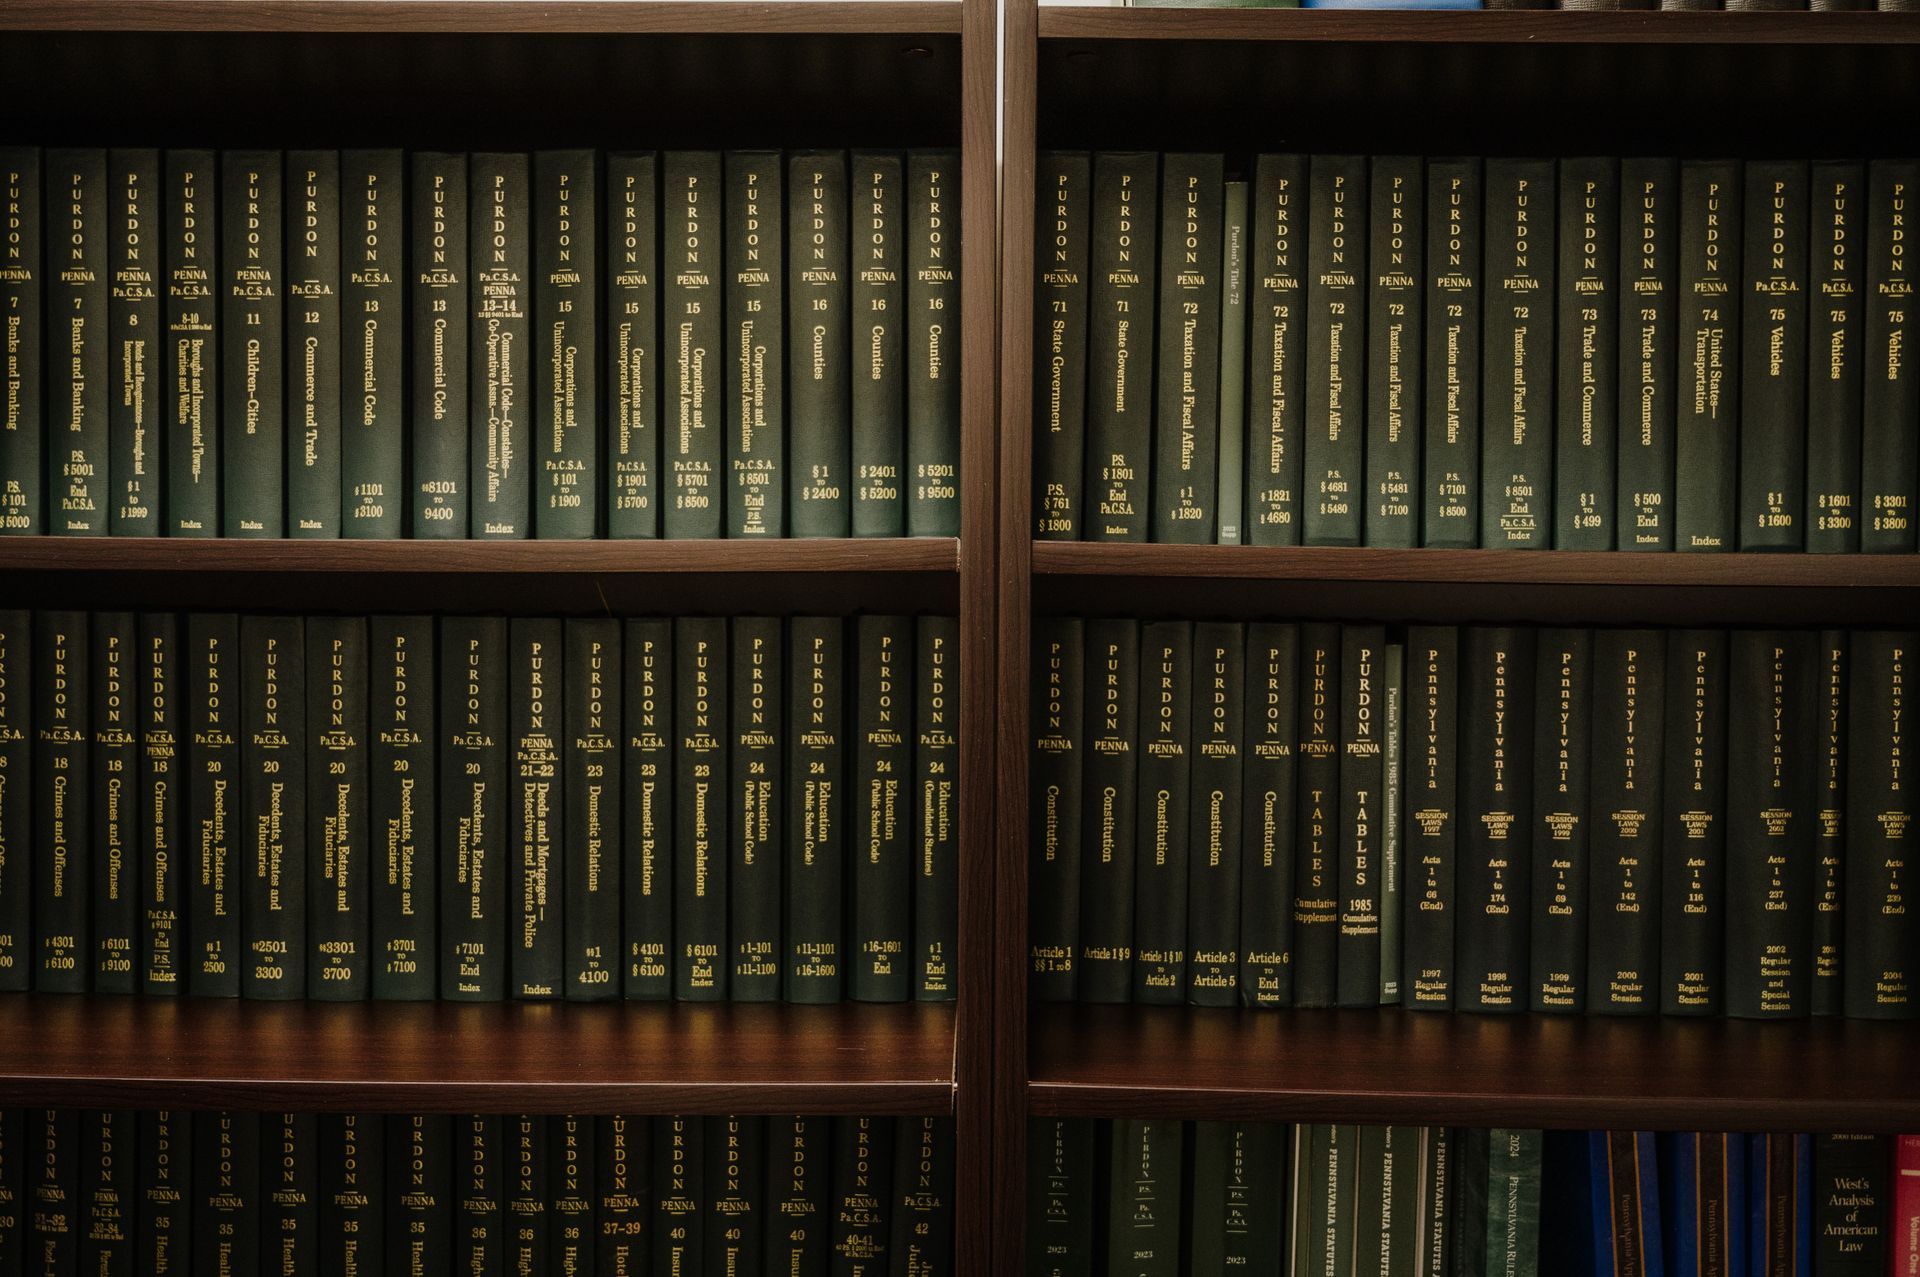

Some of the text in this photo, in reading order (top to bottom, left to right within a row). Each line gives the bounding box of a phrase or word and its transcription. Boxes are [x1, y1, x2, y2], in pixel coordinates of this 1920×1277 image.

[61, 271, 96, 281] PENNA
[421, 273, 459, 284] Pa.C.S.A.
[1044, 273, 1078, 283] PENNA
[1229, 270, 1241, 292] Title
[483, 285, 516, 296] PENNA
[1575, 281, 1604, 291] PENNA
[1755, 281, 1799, 291] Pa.C.S.A.
[74, 298, 82, 309] 7
[813, 299, 828, 311] 16
[1229, 293, 1240, 306] 72
[365, 300, 379, 312] 13
[559, 300, 572, 312] 15
[1052, 301, 1067, 313] 71
[1183, 302, 1198, 314] 72
[129, 314, 138, 326] 8
[247, 313, 261, 325] 11
[305, 311, 320, 323] 12
[477, 311, 486, 319] 13
[510, 311, 524, 319] End
[1582, 308, 1598, 321] 73
[1702, 309, 1719, 321] 74
[1770, 308, 1786, 321] 75
[813, 325, 826, 380] Counties
[872, 325, 885, 380] Counties
[1710, 328, 1723, 368] United
[1770, 326, 1784, 376] Vehicles
[70, 317, 85, 432] Banks and Banking
[364, 319, 377, 426] Commercial Code
[1051, 320, 1065, 433] State Government
[1693, 328, 1710, 414] Transportation
[178, 338, 190, 425] Charities and Welfare
[551, 321, 565, 453] Unincorporated Associations
[563, 346, 578, 427] Corporations and
[1582, 325, 1596, 446] Trade and Commerce
[1181, 319, 1197, 470] Taxation and Fiscal Affairs
[305, 336, 318, 466] Commerce and Trade
[70, 463, 94, 476] 5001
[734, 459, 776, 470] Pa.C.S.A.
[869, 465, 896, 478] 2401
[1112, 468, 1134, 480] 1801
[811, 487, 840, 499] 2400
[240, 520, 264, 530] Index
[1048, 519, 1072, 531] 1800
[1582, 515, 1602, 527] 499
[1768, 514, 1792, 526] 1600
[485, 522, 514, 534] Index
[1106, 525, 1128, 534] Index
[1691, 535, 1721, 546] Index
[920, 734, 953, 745] Pa.C.S.A.
[1347, 743, 1380, 753] PENNA
[54, 757, 68, 769] 18
[207, 761, 222, 772] 20
[750, 762, 765, 774] 24
[587, 765, 603, 777] 23
[1387, 760, 1398, 786] 1985
[759, 781, 771, 842] Education
[1387, 787, 1397, 839] Cumulative
[1414, 811, 1449, 820] SESSION
[745, 811, 755, 840] School
[1046, 785, 1059, 861] Constitution
[1420, 819, 1443, 827] LAWS
[54, 776, 67, 897] Crimes and Offenses
[589, 785, 602, 892] Domestic Relations
[534, 782, 550, 905] Deeds and Mortgages
[202, 819, 213, 885] Fiduciaries
[744, 840, 755, 865] Code)
[924, 837, 934, 876] Statutes)
[524, 782, 537, 948] Detectives and Private Police
[1422, 855, 1441, 864] Acts
[215, 846, 227, 891] Estates
[1385, 839, 1396, 893] Supplement
[1768, 890, 1784, 899] 237
[215, 893, 227, 916] and
[1350, 899, 1372, 912] 1985
[1420, 901, 1444, 911] (End)
[1342, 913, 1378, 923] Cumulative
[1194, 950, 1236, 963] Article 3
[393, 960, 416, 973] 7100
[926, 962, 946, 975] End
[1414, 980, 1447, 991] Regular
[1761, 990, 1790, 1001] Special
[1509, 1134, 1520, 1157] 2024
[1327, 1148, 1338, 1225] PENNSYLVANIA
[1834, 1177, 1869, 1190] West's
[1829, 1194, 1874, 1210] Analysis
[1507, 1175, 1520, 1249] PENNSYLVANIA
[1845, 1210, 1859, 1222] of
[155, 1216, 170, 1228] 35
[670, 1227, 685, 1239] 40
[1824, 1223, 1878, 1235] American
[1839, 1240, 1863, 1252] Law
[1133, 1250, 1153, 1259] 2023
[1909, 1253, 1920, 1274] One
